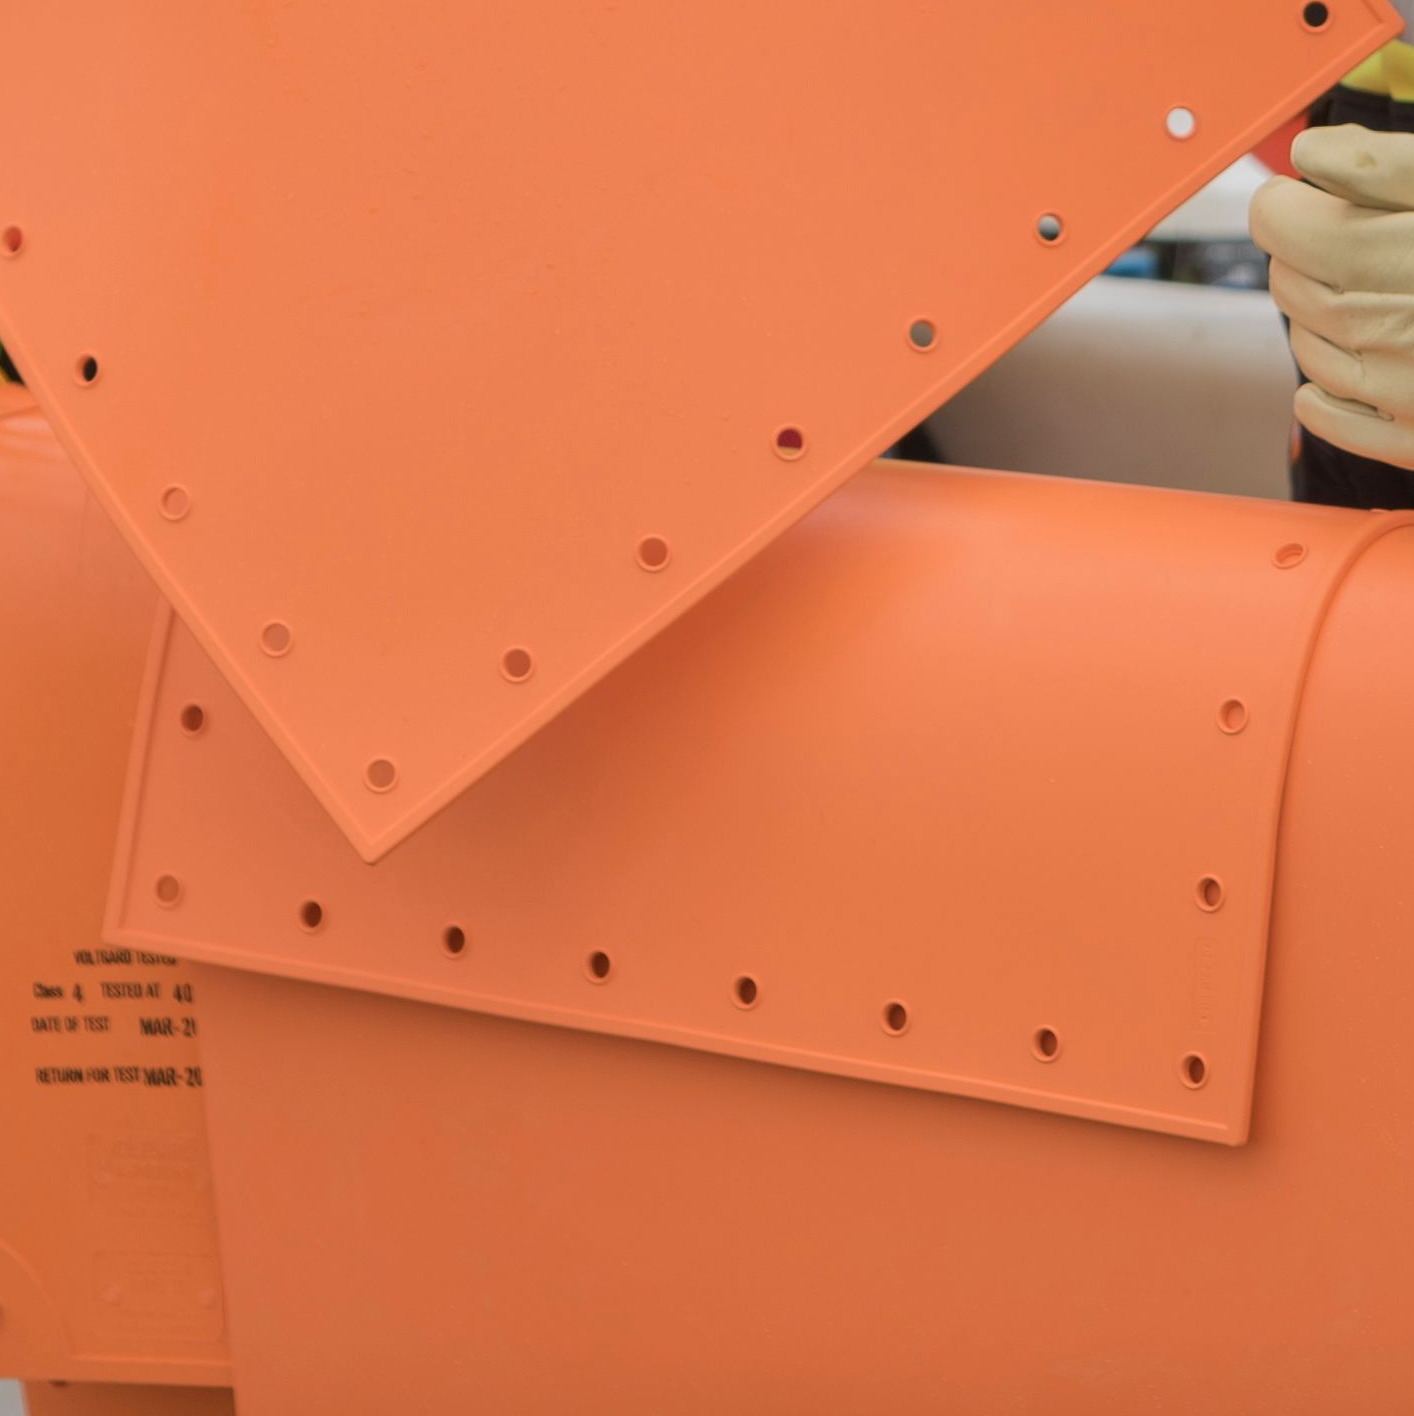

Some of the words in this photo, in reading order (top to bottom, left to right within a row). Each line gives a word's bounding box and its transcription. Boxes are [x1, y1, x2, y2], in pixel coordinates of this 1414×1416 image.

[73, 949, 132, 966] VOLTGARD
[33, 982, 64, 999] Class
[73, 984, 83, 1002] 4
[99, 982, 143, 999] TESTED
[146, 982, 160, 998] AT
[173, 983, 193, 1003] 40
[31, 1016, 61, 1032] DATE
[65, 1016, 78, 1031] OF
[84, 1015, 110, 1031] TEST
[36, 1067, 83, 1083] RETURN
[87, 1068, 109, 1083] FOR
[114, 1066, 140, 1082] TEST
